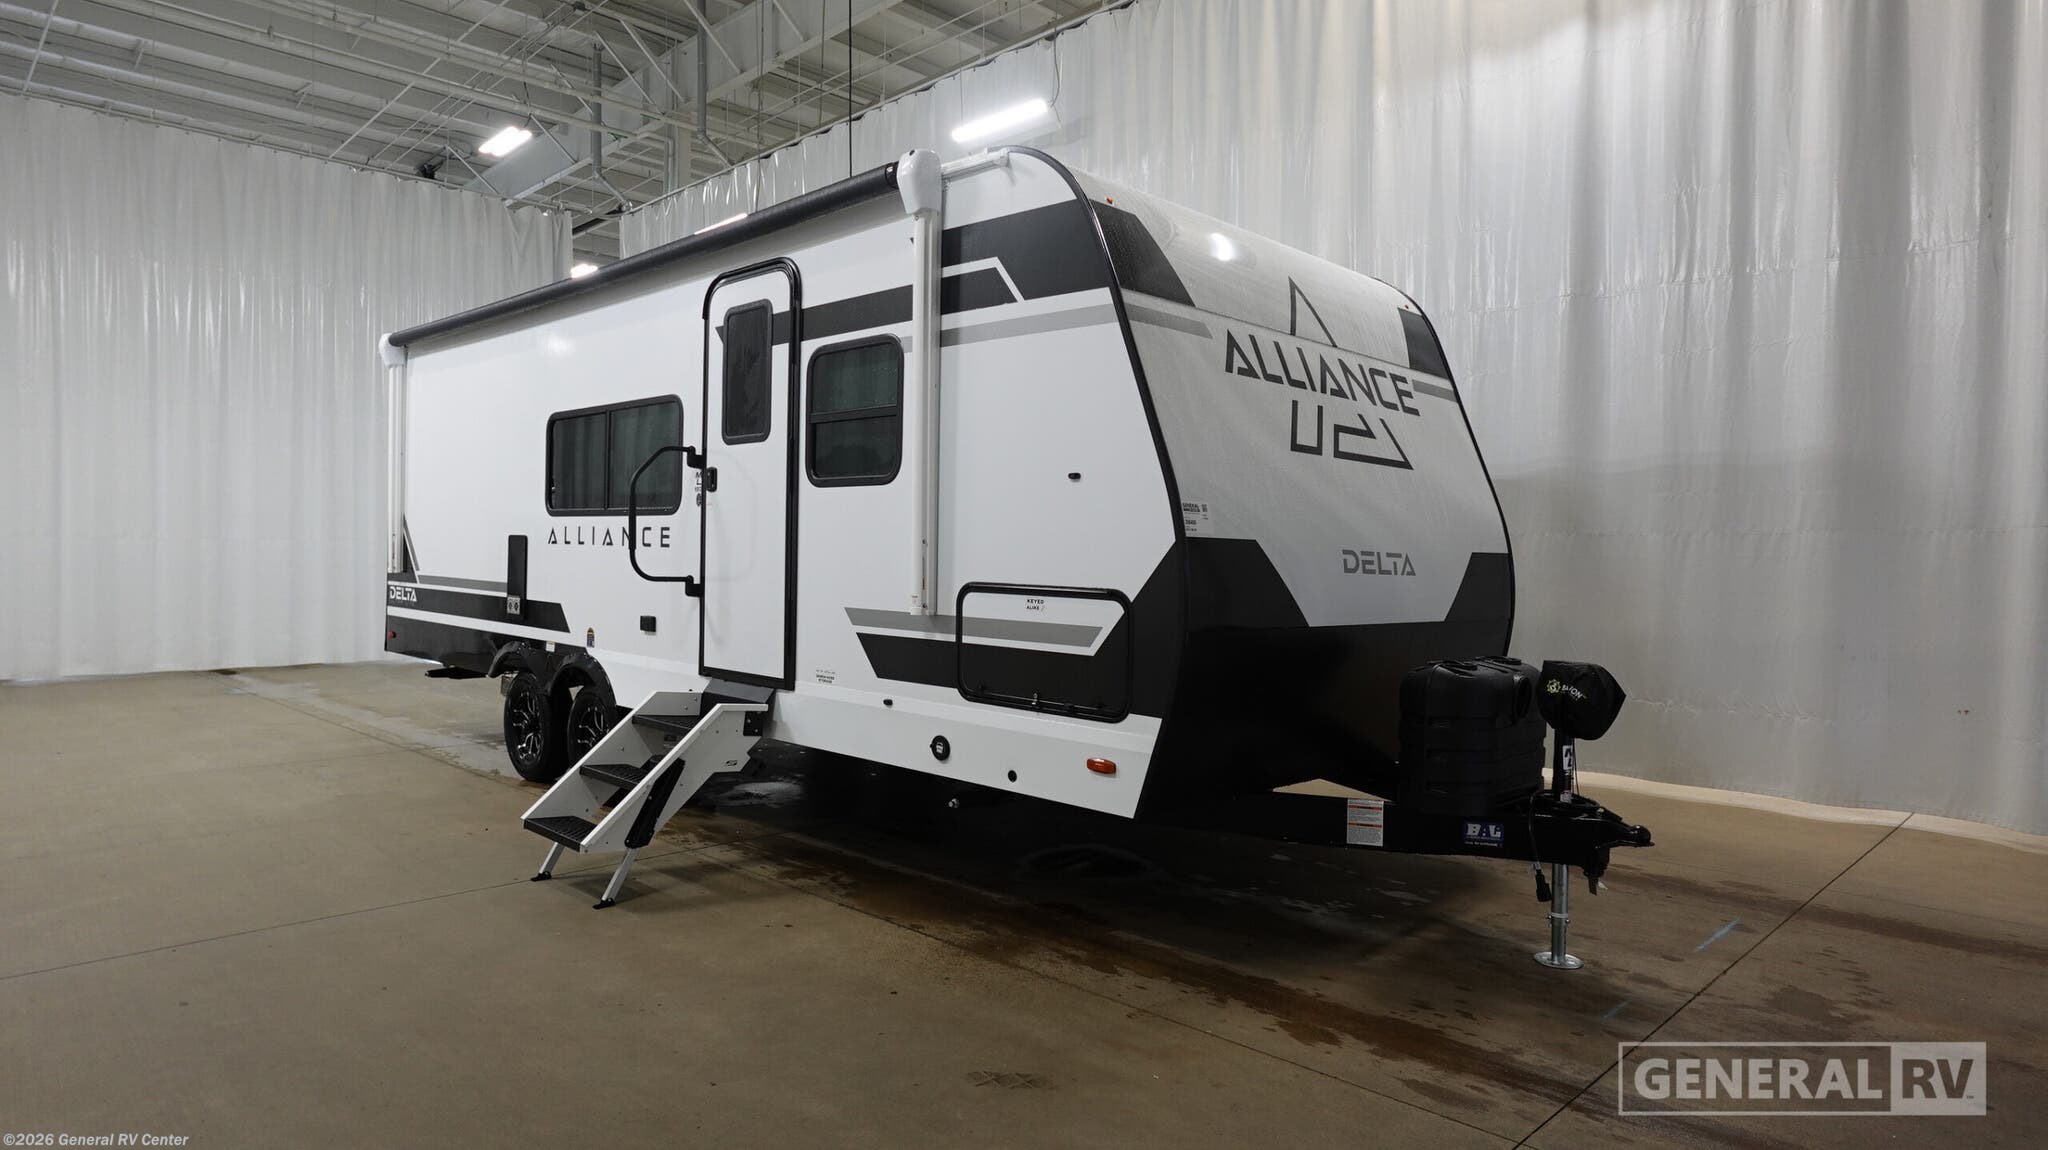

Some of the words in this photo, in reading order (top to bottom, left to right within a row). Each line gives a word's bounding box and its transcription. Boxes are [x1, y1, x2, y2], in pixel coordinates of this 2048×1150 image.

[1225, 329, 1420, 416] ALLIANCE
[548, 526, 670, 547] ALLIANCE
[1342, 549, 1416, 576] DELTA
[390, 586, 417, 602] DELTA
